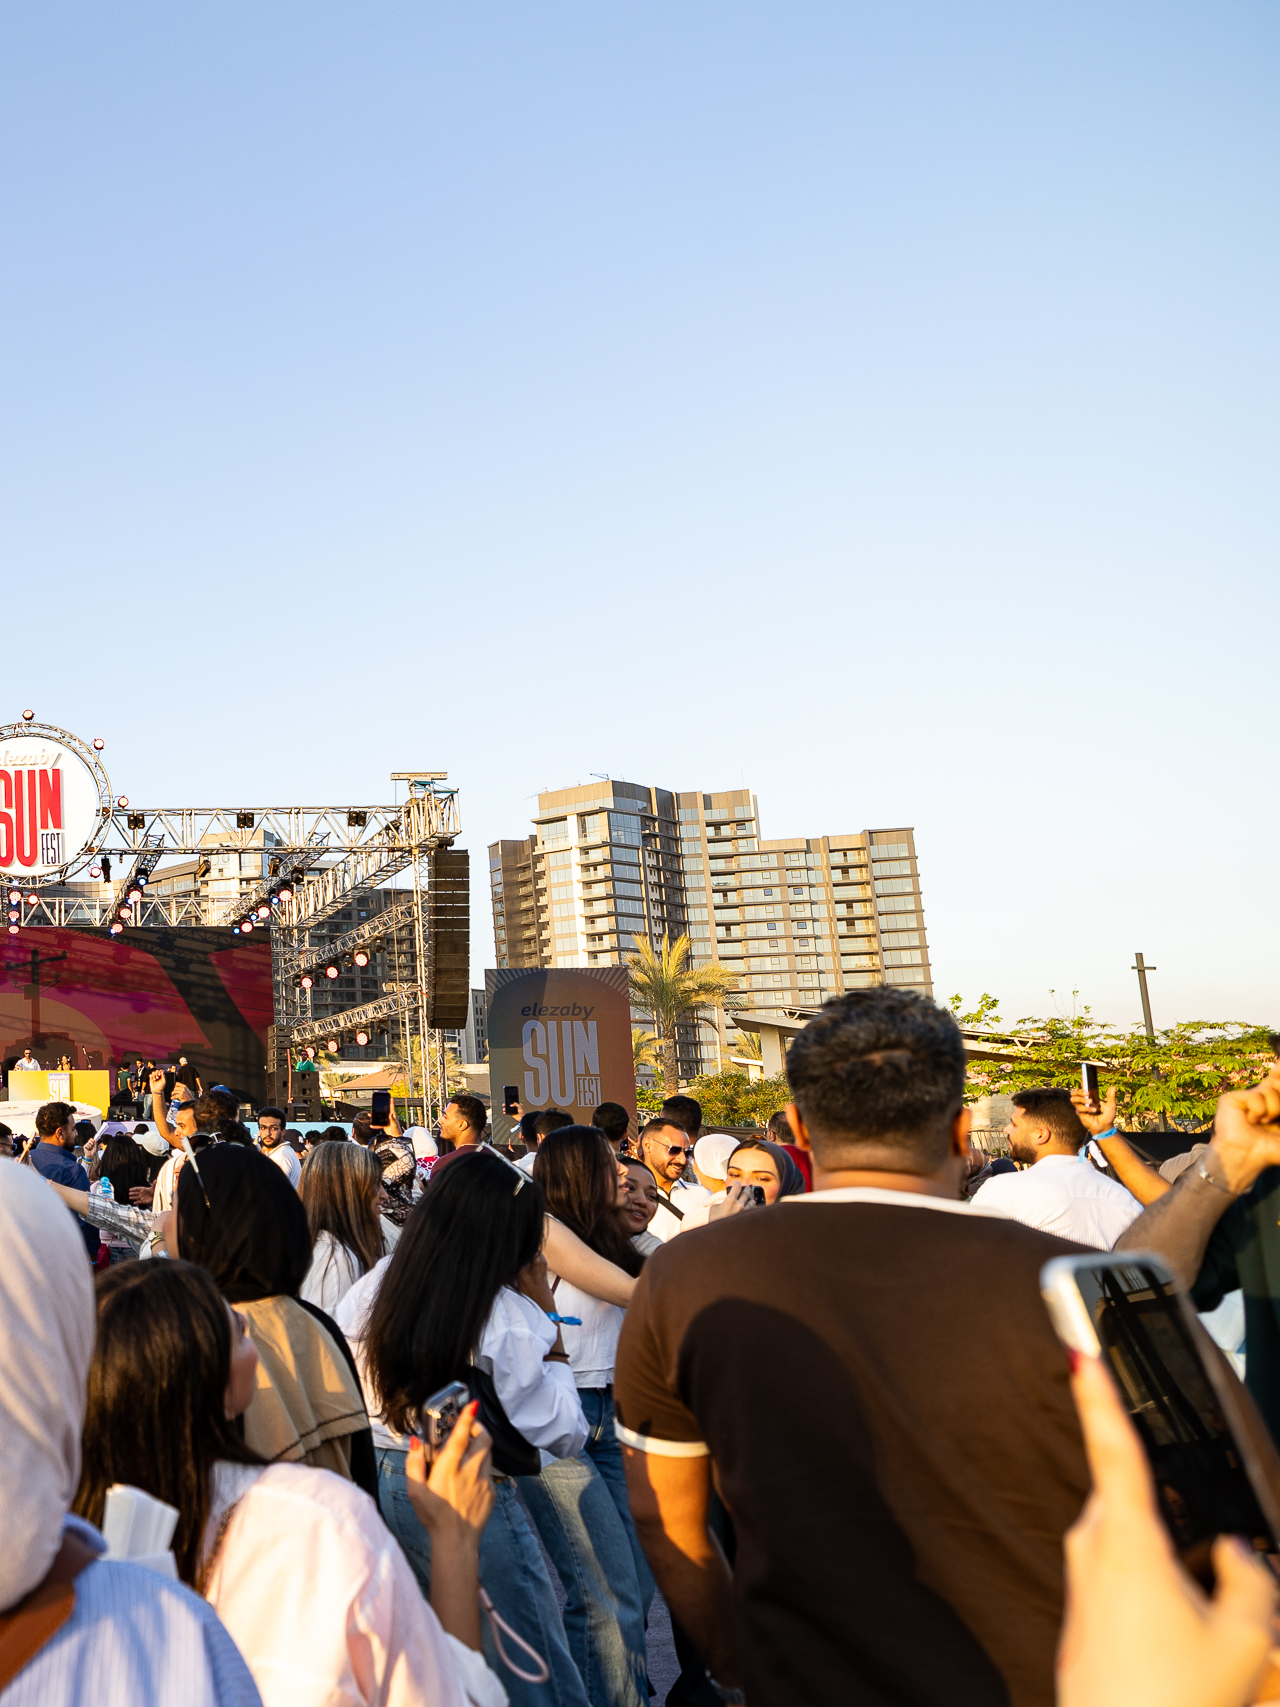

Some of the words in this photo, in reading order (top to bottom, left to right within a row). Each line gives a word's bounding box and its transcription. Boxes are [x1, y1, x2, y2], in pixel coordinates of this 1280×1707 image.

[41, 833, 61, 865] FEST
[521, 1002, 595, 1020] elezaby
[521, 1019, 600, 1106] SUN
[49, 1080, 69, 1102] SUN
[577, 1077, 600, 1106] FEST
